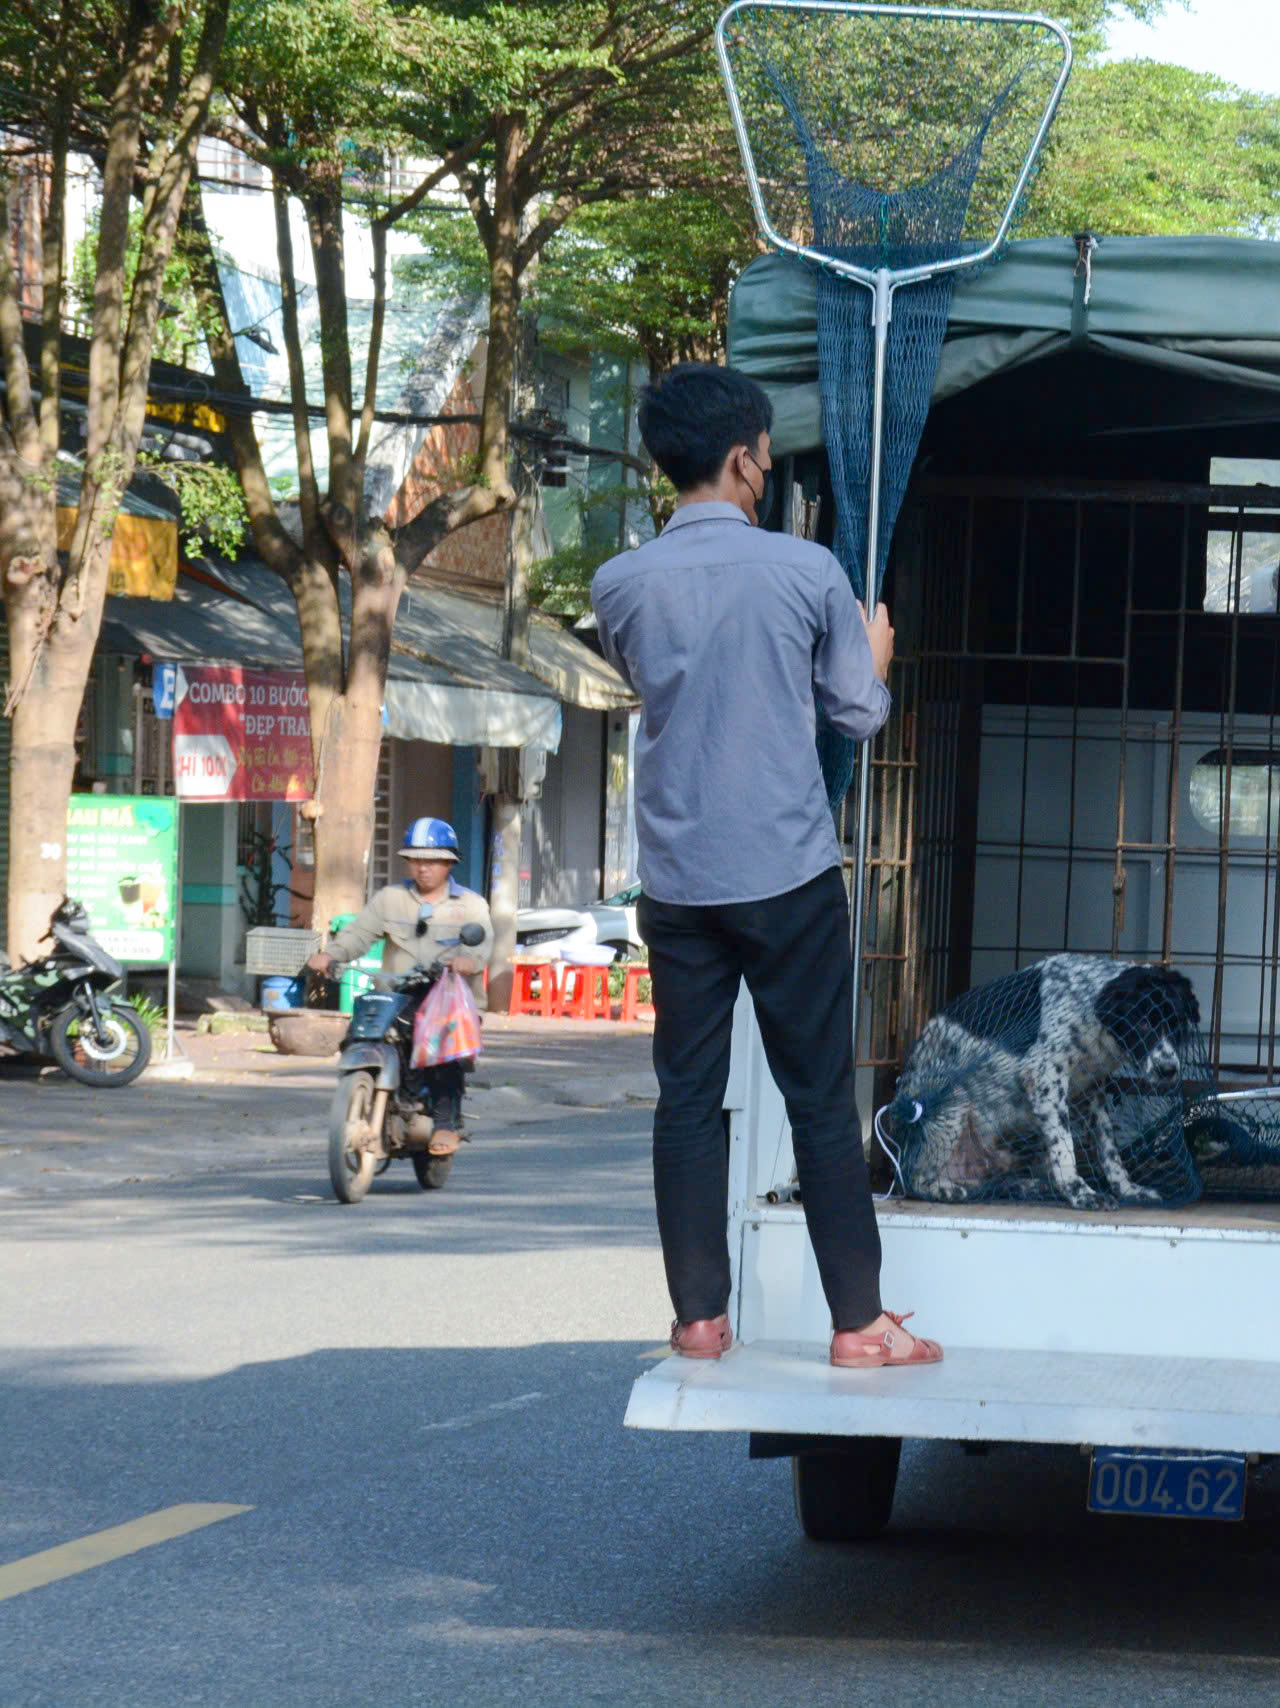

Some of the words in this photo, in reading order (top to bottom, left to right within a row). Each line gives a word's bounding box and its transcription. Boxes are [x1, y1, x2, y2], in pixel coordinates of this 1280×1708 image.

[189, 682, 246, 704] COMBO
[250, 687, 265, 705] 10
[279, 715, 310, 737] TRA
[1096, 1463, 1239, 1513] 004.62
